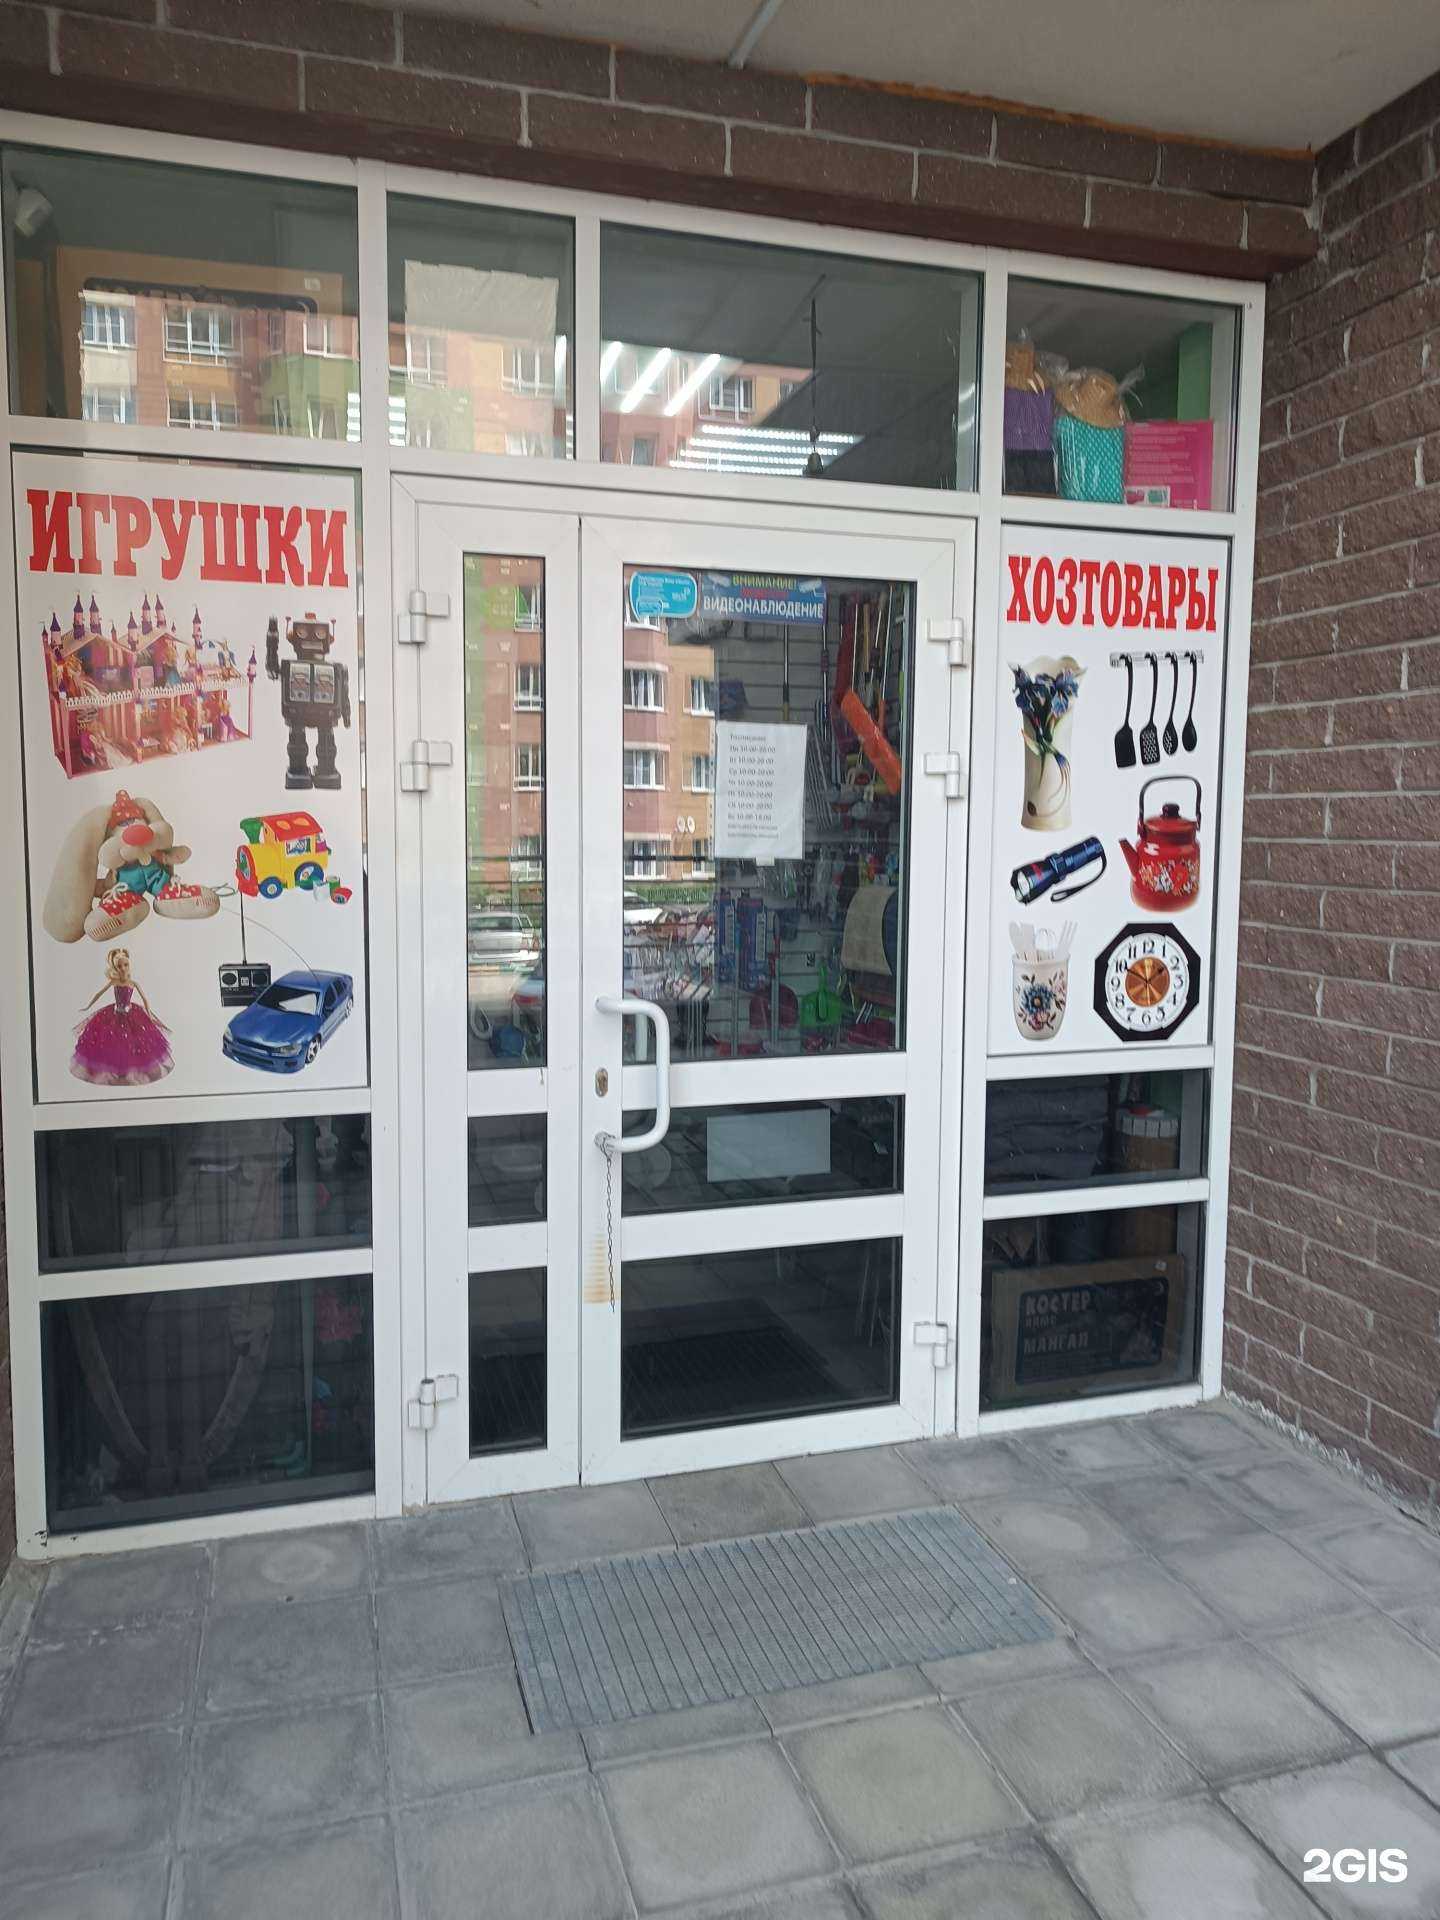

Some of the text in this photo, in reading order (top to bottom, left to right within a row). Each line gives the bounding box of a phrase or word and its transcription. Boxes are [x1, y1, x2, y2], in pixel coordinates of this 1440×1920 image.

[27, 488, 349, 588] ИГРУШКИ
[1006, 555, 1219, 632] ХОЗТОВАРЫ
[703, 596, 824, 620] ВИДЕОНАБЛЮДЕНИЕ
[1142, 939, 1155, 954] 12
[1116, 960, 1127, 973] 10
[1170, 956, 1179, 970] 2
[1111, 977, 1120, 992] 9
[1174, 975, 1183, 989] 3
[1115, 993, 1125, 1009] 8
[1127, 1007, 1136, 1023] 7
[1142, 1010, 1151, 1025] 6
[1025, 1290, 1091, 1316] КОСТЕР
[1023, 1331, 1089, 1355] МАНГАЛ
